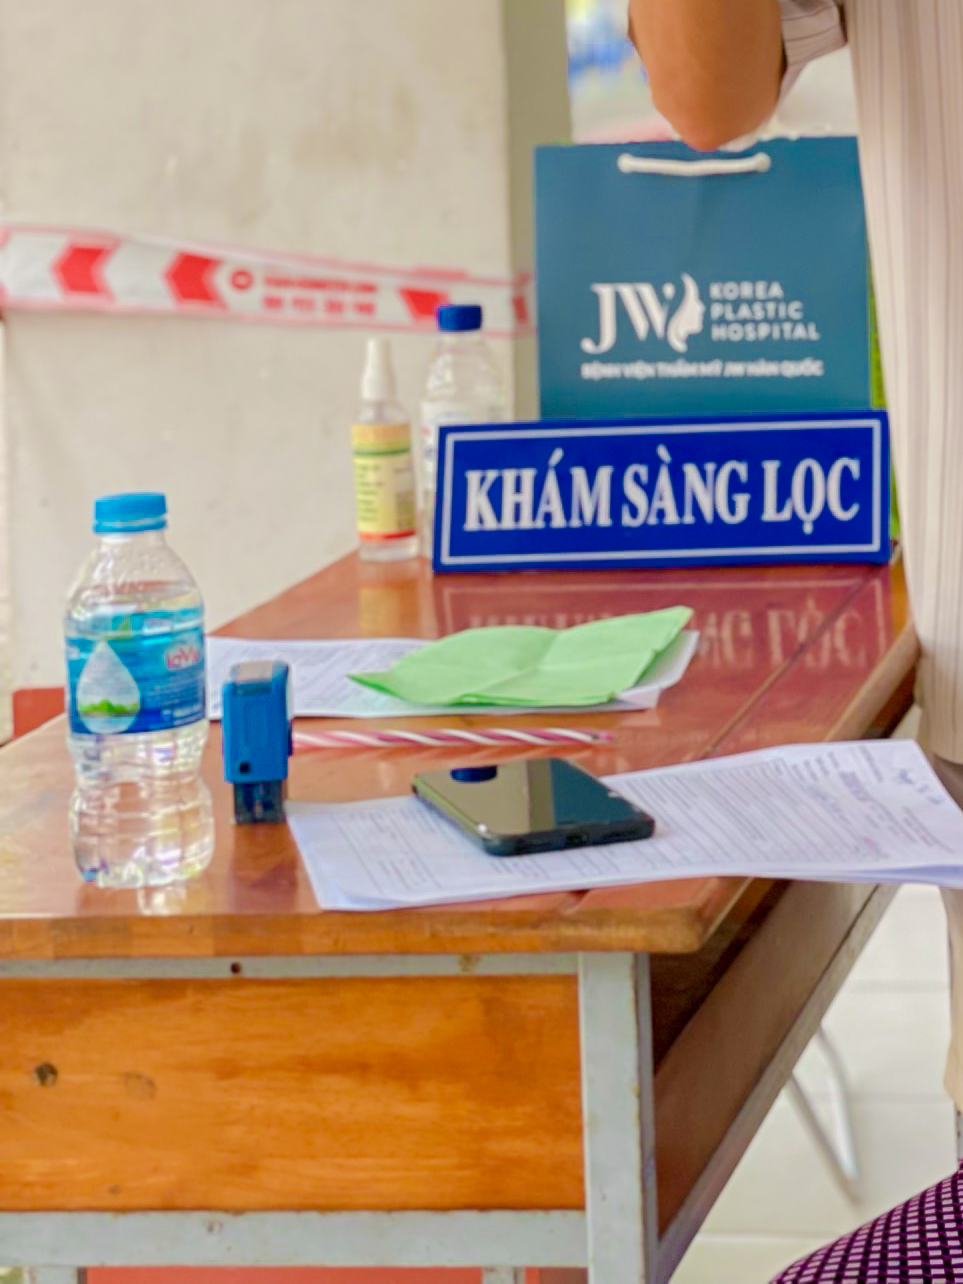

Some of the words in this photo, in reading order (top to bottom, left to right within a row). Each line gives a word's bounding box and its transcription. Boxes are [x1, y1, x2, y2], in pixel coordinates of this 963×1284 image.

[709, 280, 784, 300] KOREA
[710, 300, 804, 321] PLASTIC
[711, 321, 821, 342] HOSPITAL
[463, 447, 615, 532] KHÁM
[621, 444, 752, 528] SÀNG
[760, 457, 861, 535] LỌC
